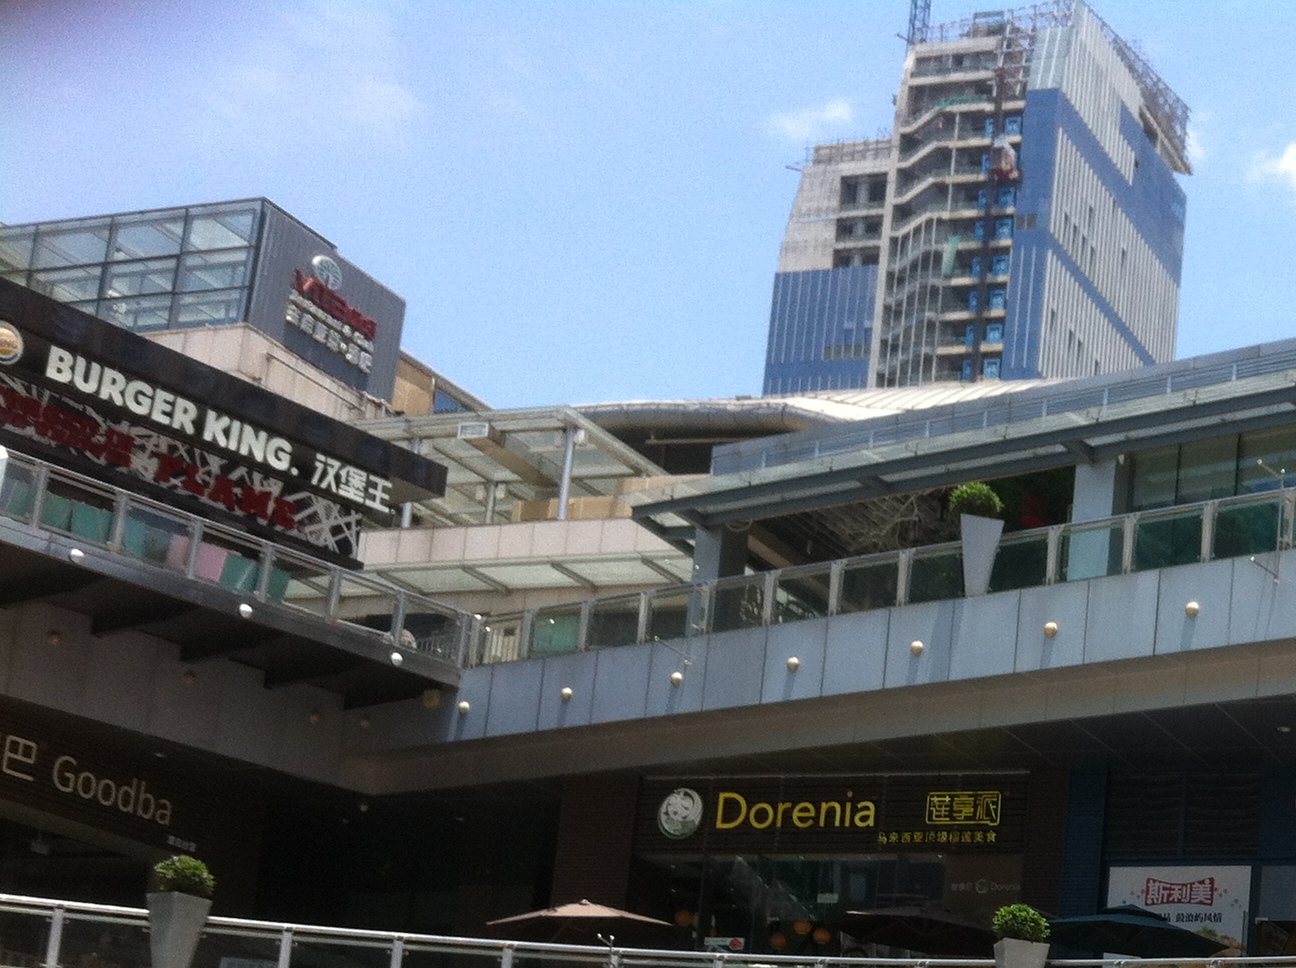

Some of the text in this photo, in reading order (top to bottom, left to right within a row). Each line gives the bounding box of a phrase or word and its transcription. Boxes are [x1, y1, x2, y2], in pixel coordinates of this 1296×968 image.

[46, 344, 198, 435] BURGER
[311, 452, 394, 514] 汉堡王
[53, 755, 172, 826] Goodba
[716, 790, 875, 829] Dorenia
[1147, 879, 1213, 904] 斯利美
